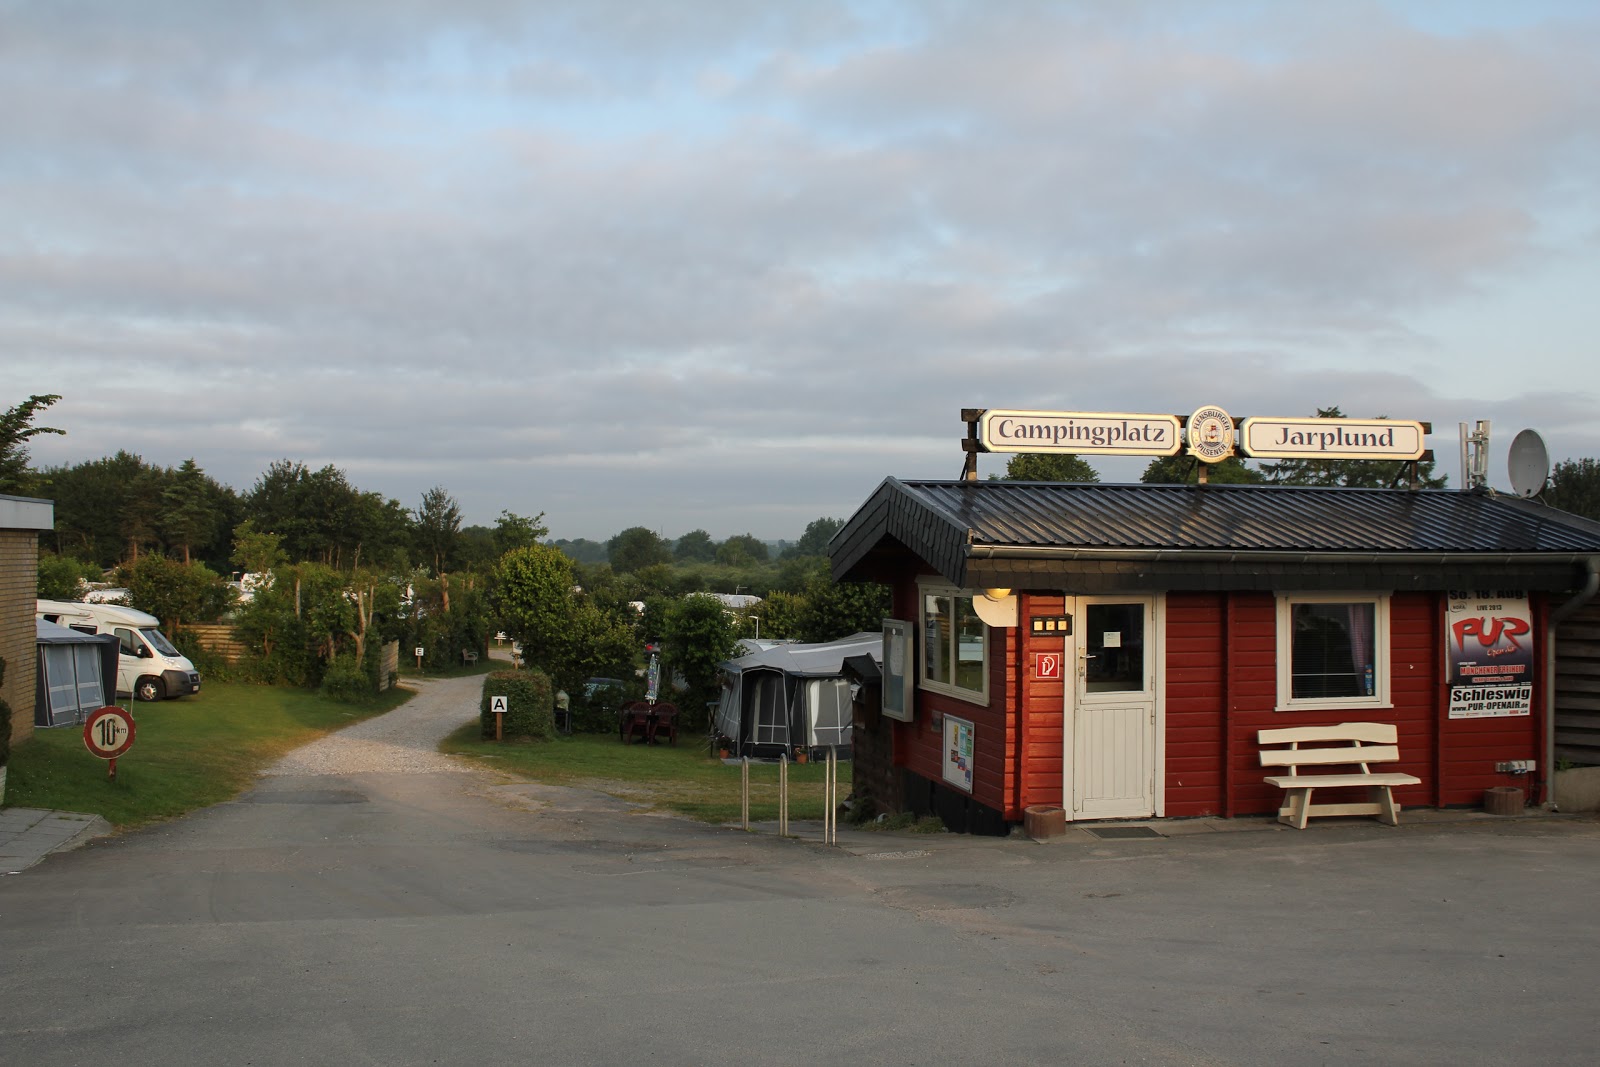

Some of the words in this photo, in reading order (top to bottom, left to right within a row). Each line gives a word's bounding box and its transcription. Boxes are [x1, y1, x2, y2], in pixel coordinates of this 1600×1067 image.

[1193, 410, 1231, 431] FLENSBURGER
[998, 419, 1165, 446] Campingplatz
[1276, 427, 1394, 450] Jarplund
[1196, 443, 1228, 456] PILSENER
[1452, 616, 1531, 653] PUR
[494, 698, 504, 710] A
[1453, 688, 1530, 702] Schleswig
[1452, 701, 1528, 711] www.PUR-OPENAIR.de
[95, 718, 116, 746] 10
